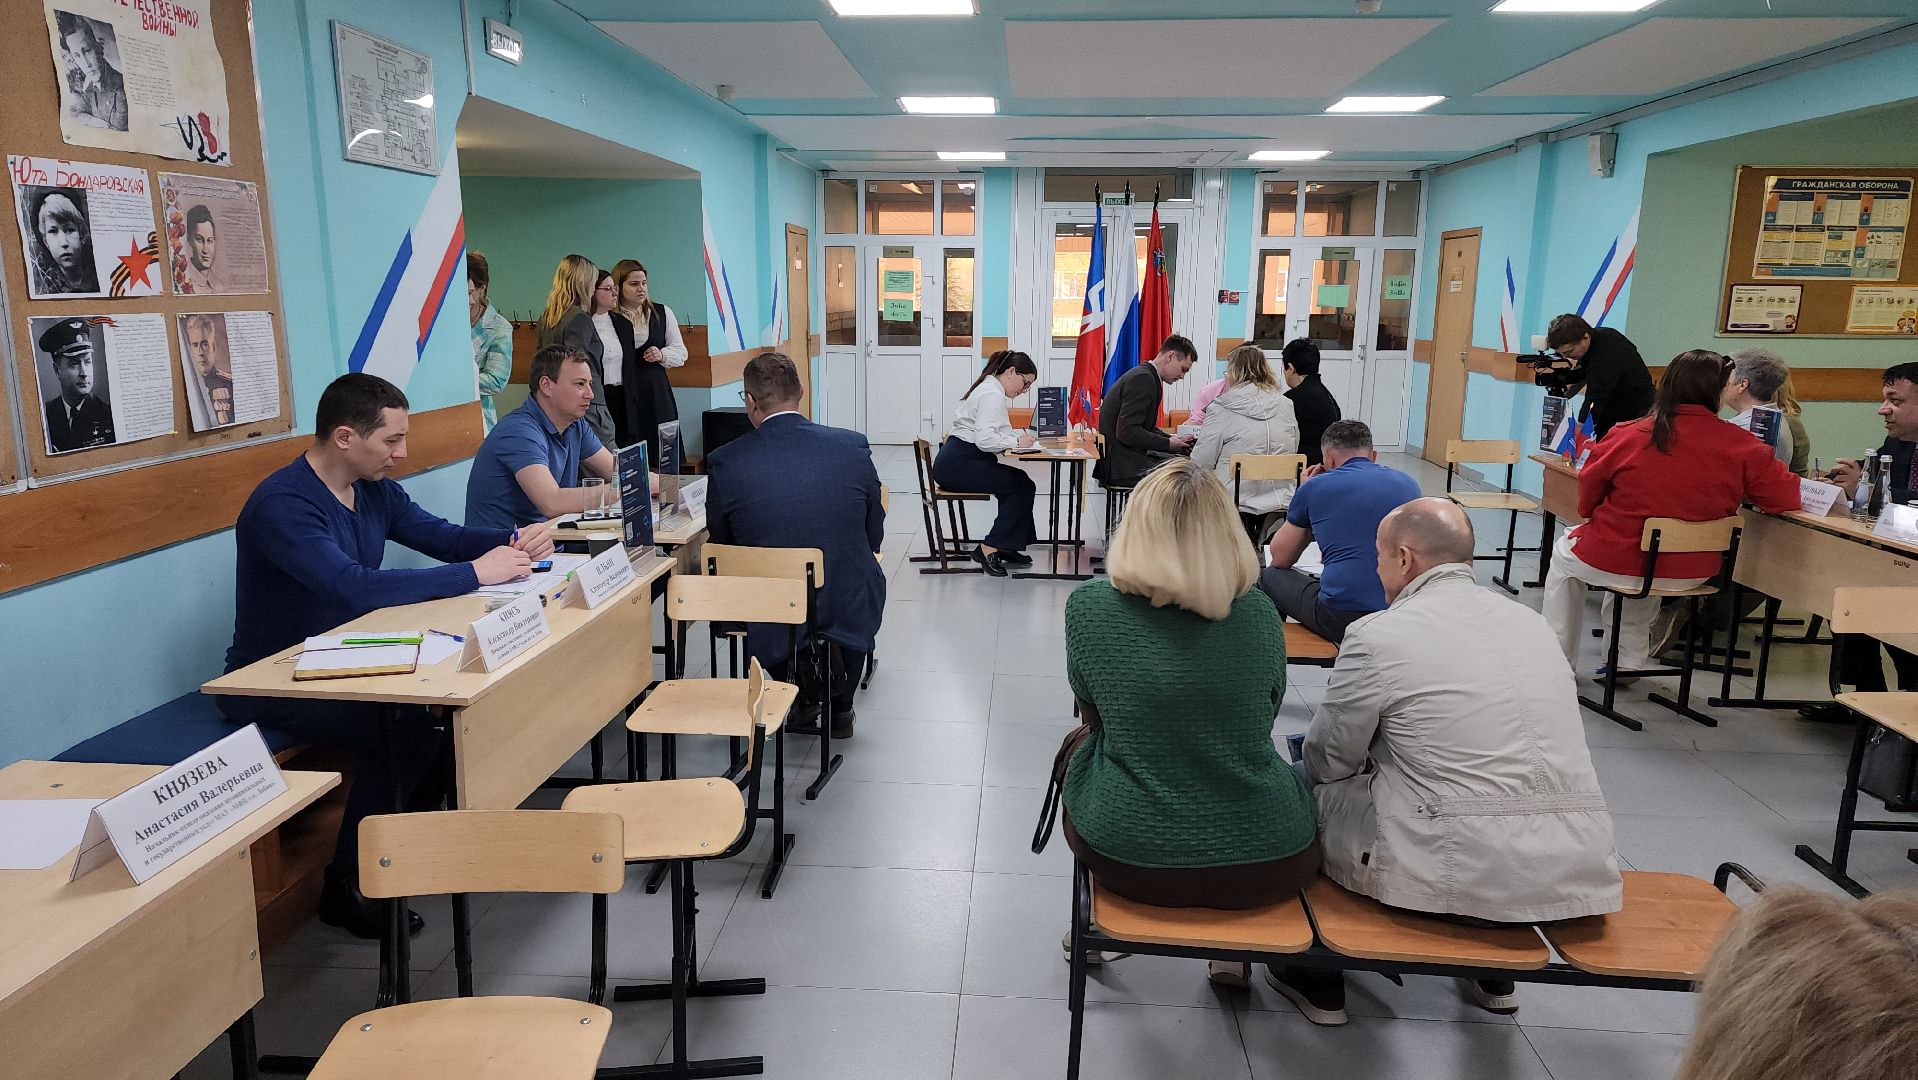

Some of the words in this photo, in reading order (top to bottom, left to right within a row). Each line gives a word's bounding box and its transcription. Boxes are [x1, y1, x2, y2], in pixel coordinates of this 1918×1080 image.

[114, 0, 199, 28] ЕСТВЕННОЙ
[142, 12, 176, 37] ВОЙНЫ
[1792, 181, 1856, 189] ГРАЖДАНСКАЯ
[1858, 182, 1899, 190] ОБОРОНА
[1105, 198, 1132, 206] ВЫХО
[153, 755, 228, 805] КНЯЗЕВА
[134, 799, 200, 844] Анастасия
[199, 761, 264, 804] Валерьевна
